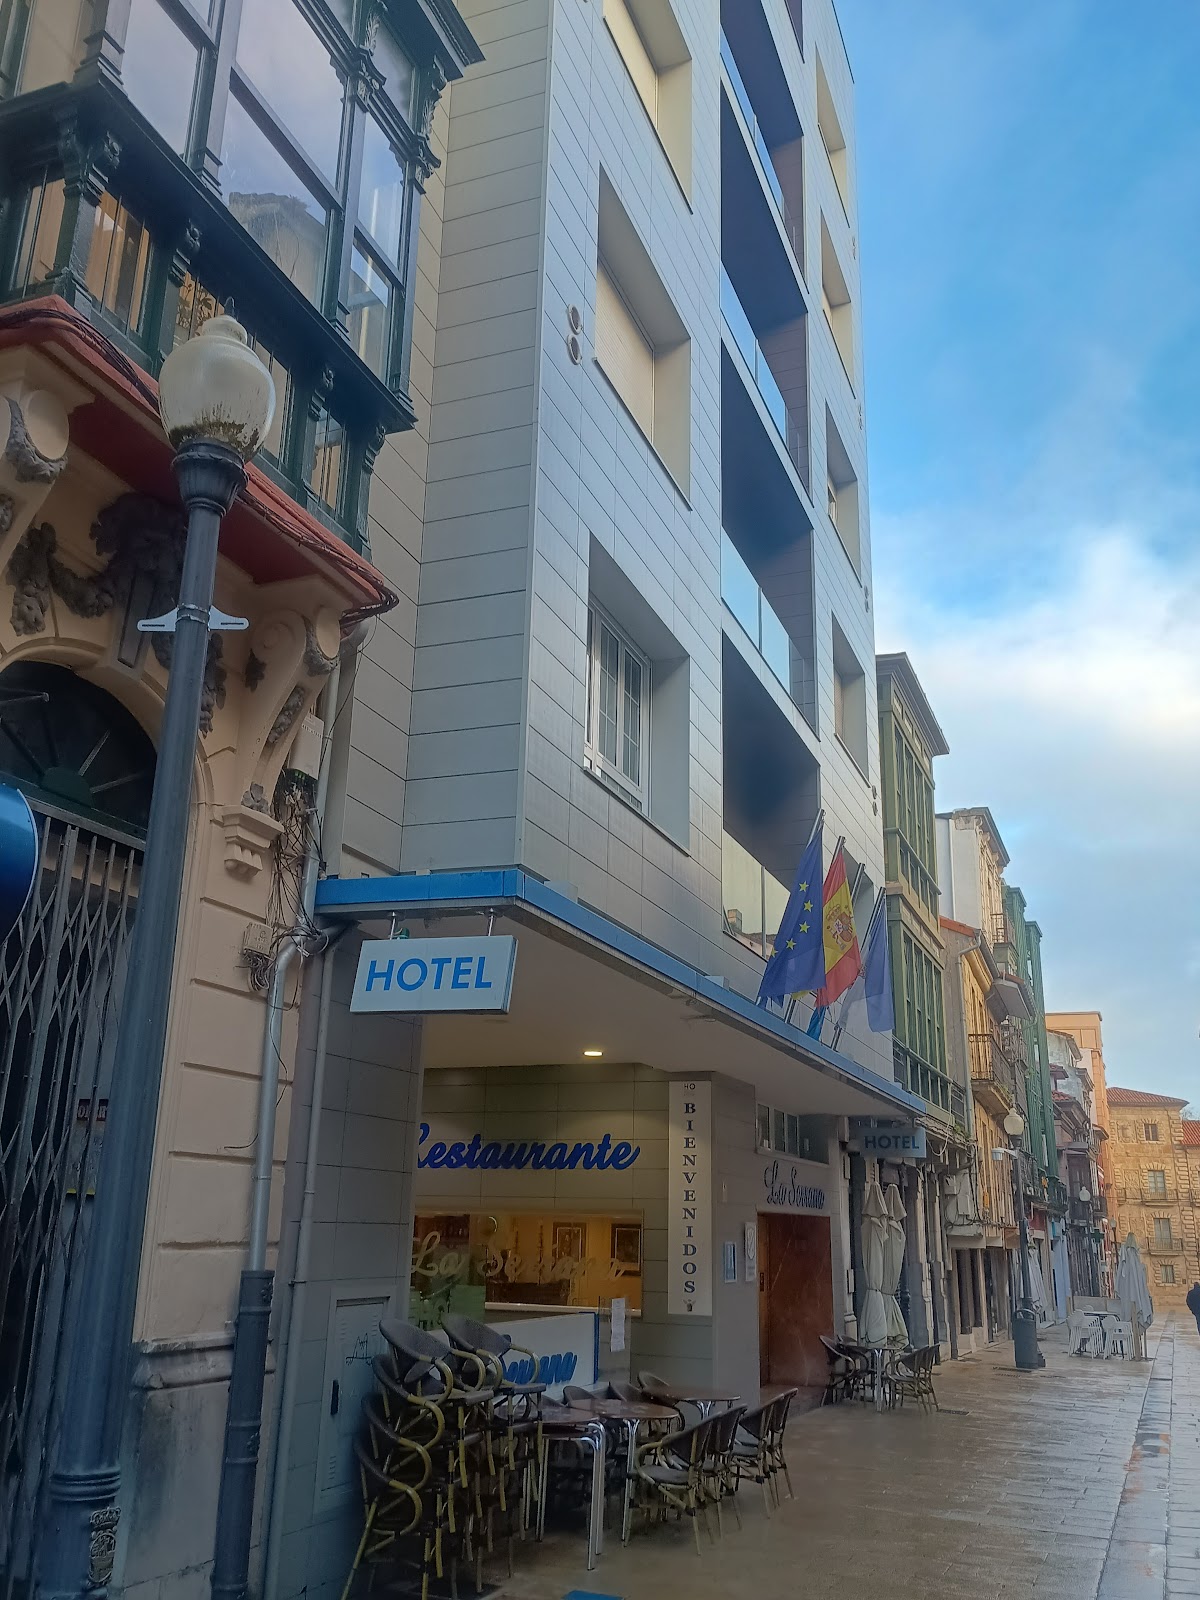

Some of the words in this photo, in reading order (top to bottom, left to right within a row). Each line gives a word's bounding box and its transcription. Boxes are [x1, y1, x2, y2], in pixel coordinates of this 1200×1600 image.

[365, 956, 492, 992] HOTEL
[864, 1134, 920, 1149] HOTEL
[682, 1102, 697, 1294] BIENVENIDOS
[764, 1160, 787, 1205] La
[411, 1231, 465, 1276] La
